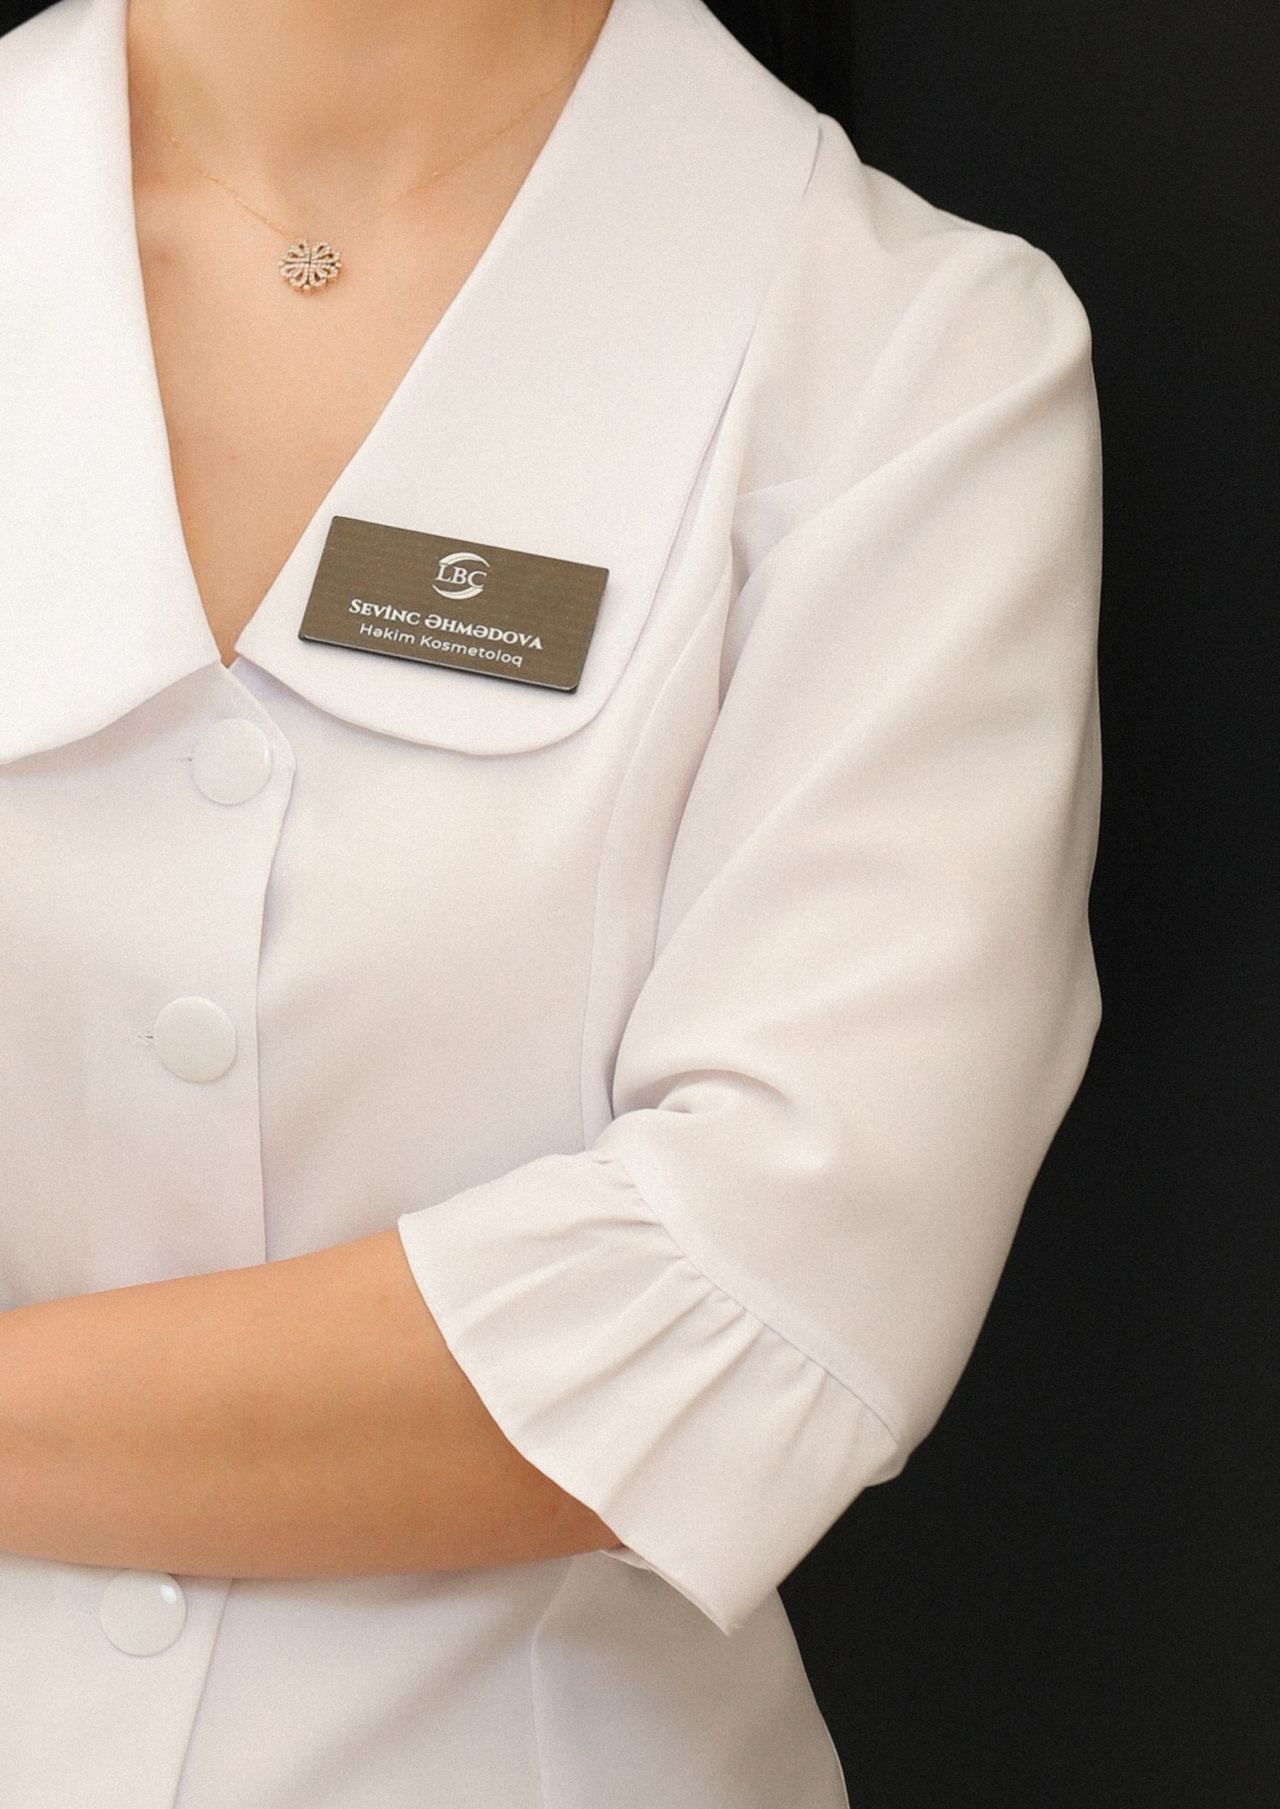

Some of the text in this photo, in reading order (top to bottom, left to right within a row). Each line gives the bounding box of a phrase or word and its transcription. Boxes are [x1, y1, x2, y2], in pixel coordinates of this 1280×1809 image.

[435, 564, 487, 589] LBC
[349, 598, 543, 650] SEVİNC ƏHMƏDOVA
[359, 623, 524, 668] Həkim Kosmetoloq
